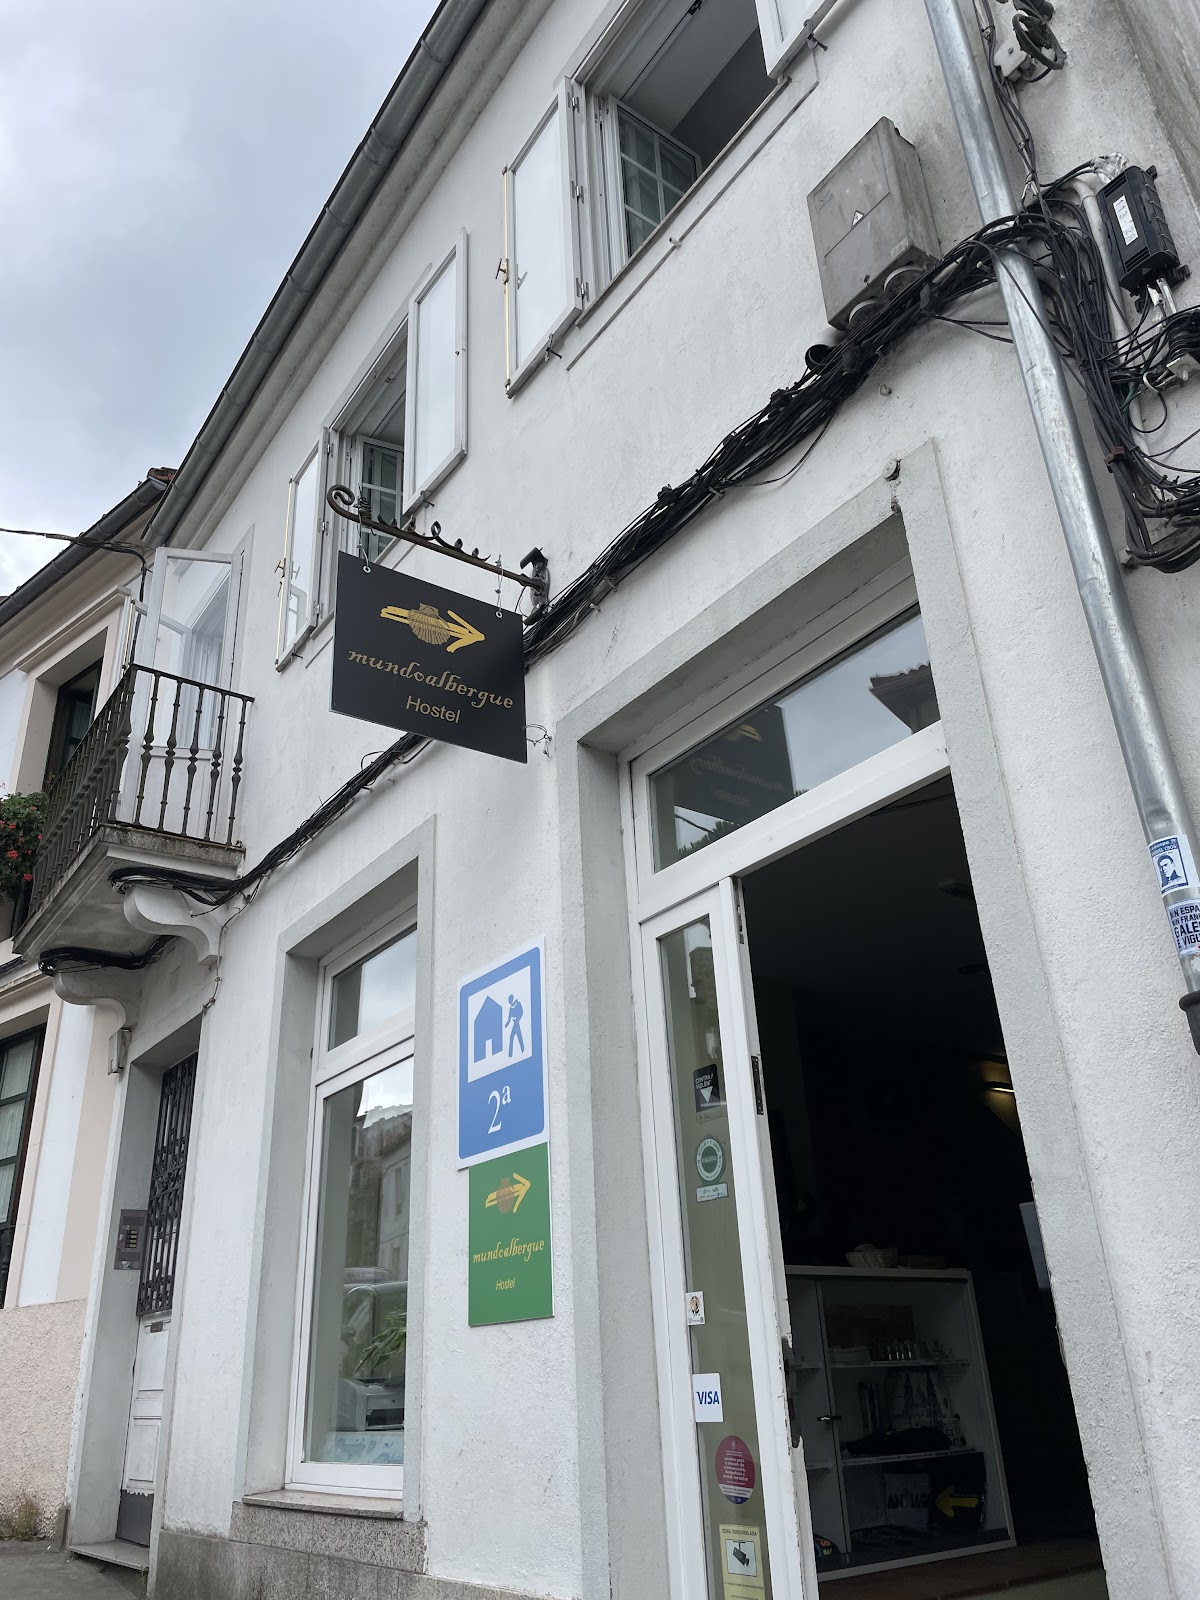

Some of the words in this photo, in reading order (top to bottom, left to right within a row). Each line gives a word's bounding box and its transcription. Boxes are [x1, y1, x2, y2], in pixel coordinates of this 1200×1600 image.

[348, 650, 513, 709] mundoalbergue
[405, 695, 461, 724] Hostel
[1180, 913, 1200, 923] FRAN
[1174, 921, 1200, 938] GALE
[472, 1237, 545, 1263] mundoalbergue
[495, 1276, 516, 1291] Hostel
[696, 1391, 720, 1405] VISA
